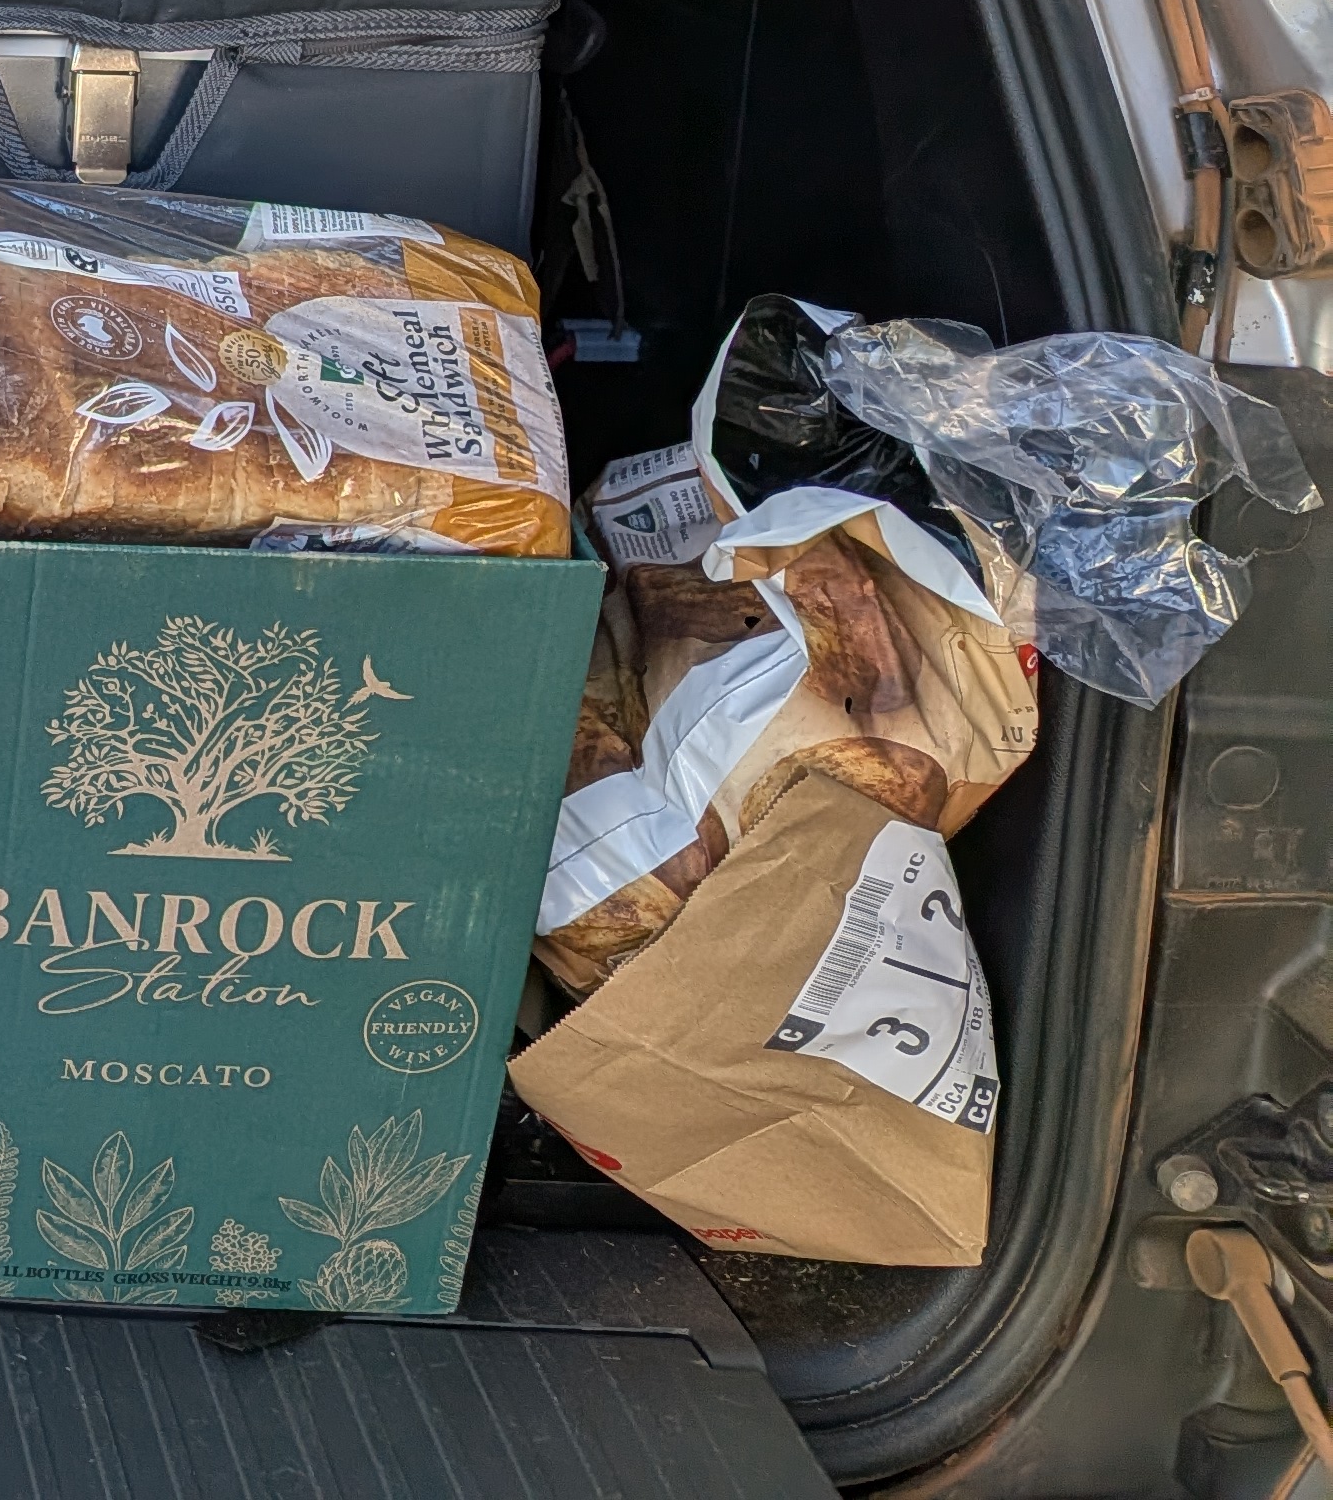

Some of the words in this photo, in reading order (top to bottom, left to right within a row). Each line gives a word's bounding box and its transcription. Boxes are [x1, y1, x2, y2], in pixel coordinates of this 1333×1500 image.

[301, 327, 341, 352] AKERY
[245, 348, 260, 370] 50
[298, 354, 369, 432] WOOLWORTH
[361, 352, 420, 414] Sft
[392, 309, 452, 460] Whlemeal
[903, 852, 925, 884] QC
[921, 889, 964, 932] 2
[37, 938, 323, 1016] Station
[387, 988, 464, 1014] VEGAN
[370, 1020, 473, 1036] FRIENDLY
[970, 1006, 984, 1032] 08
[779, 1028, 804, 1043] C
[866, 1016, 931, 1056] 3
[389, 1042, 449, 1064] WINE
[61, 1058, 271, 1088] MOSCATO
[937, 1081, 969, 1116] CC4
[967, 1087, 993, 1125] CC
[3, 1265, 23, 1279] 1L
[24, 1266, 105, 1284] BOTTLES
[113, 1270, 170, 1285] GROSS
[172, 1271, 244, 1288] WEIGHT
[246, 1275, 292, 1292] 9.8kg
